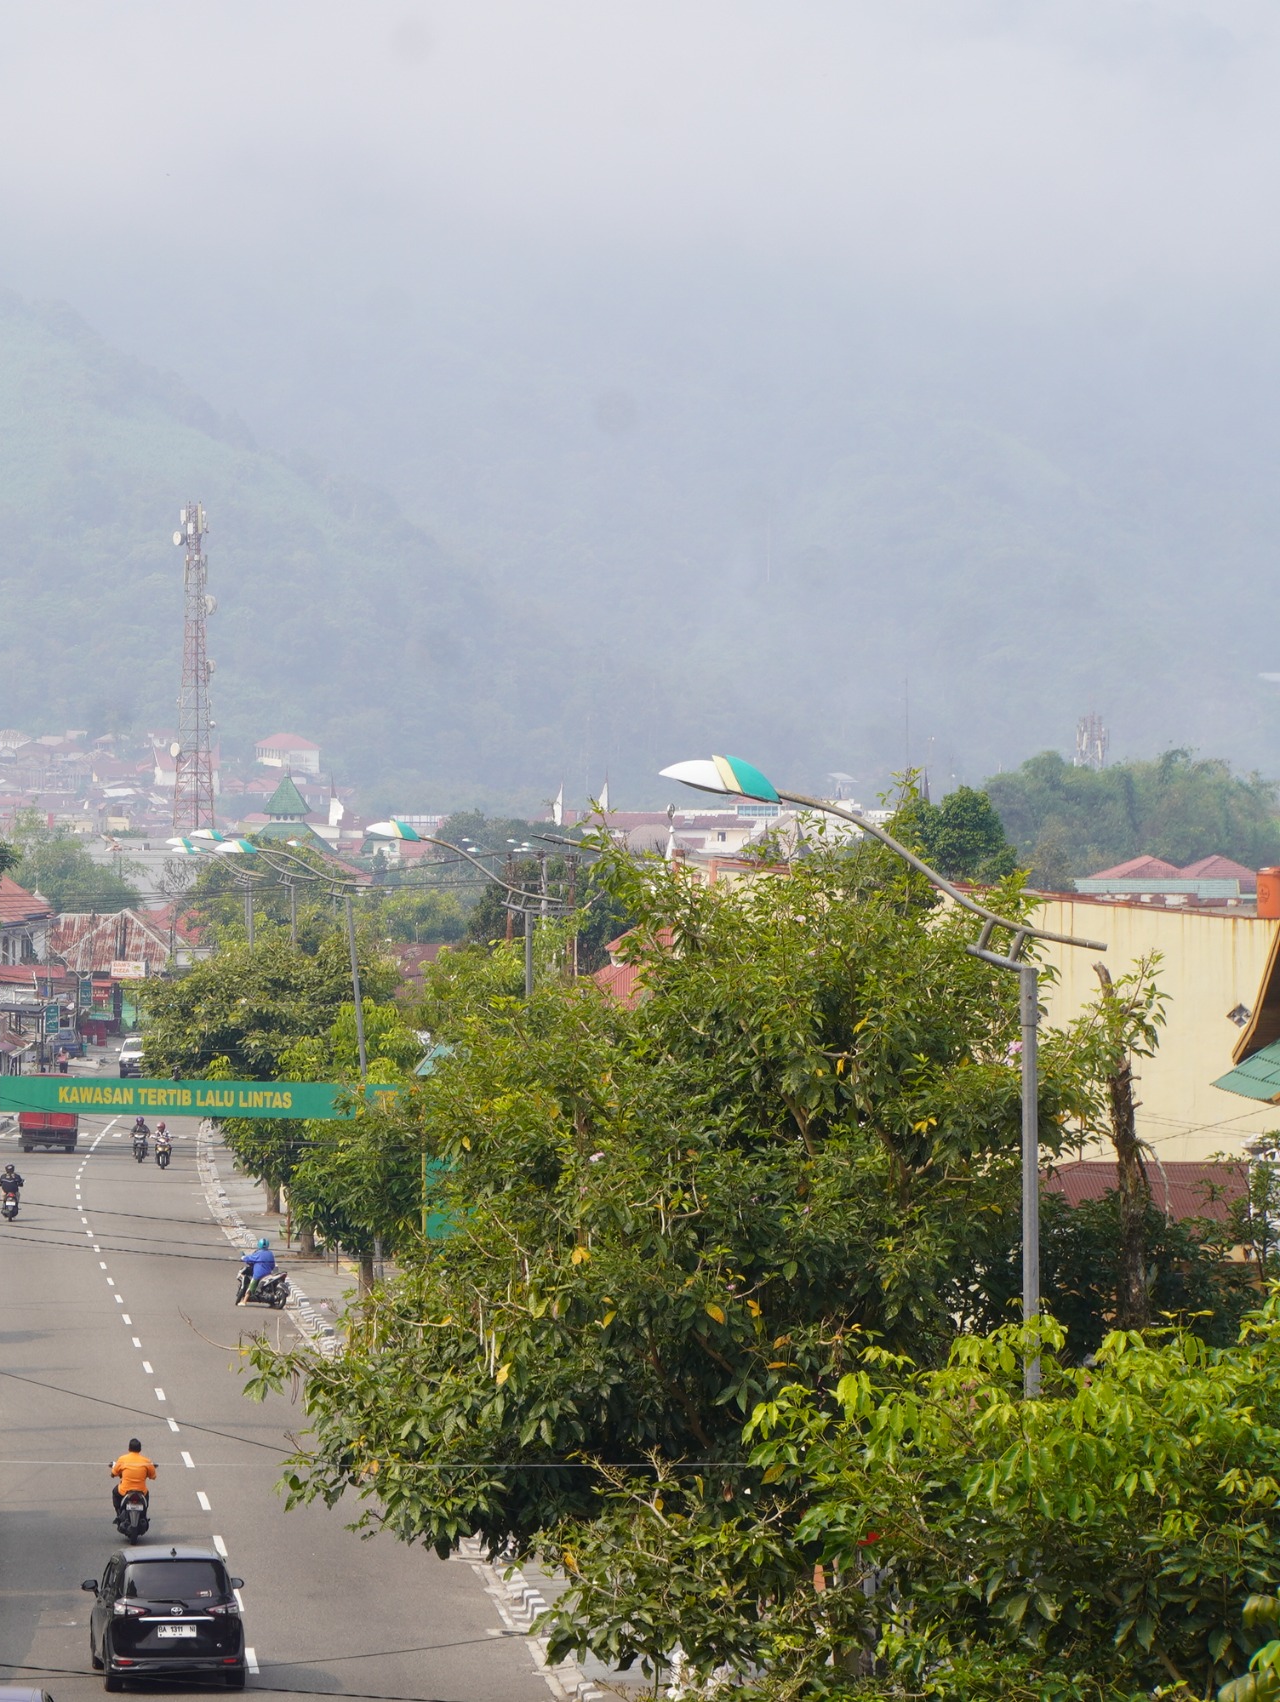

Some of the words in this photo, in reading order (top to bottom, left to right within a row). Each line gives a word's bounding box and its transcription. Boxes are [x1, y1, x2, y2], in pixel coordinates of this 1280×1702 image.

[59, 1087, 134, 1105] KAWASAN
[138, 1088, 192, 1106] TERTIB
[196, 1090, 235, 1107] LALU
[239, 1091, 293, 1109] LINTAS
